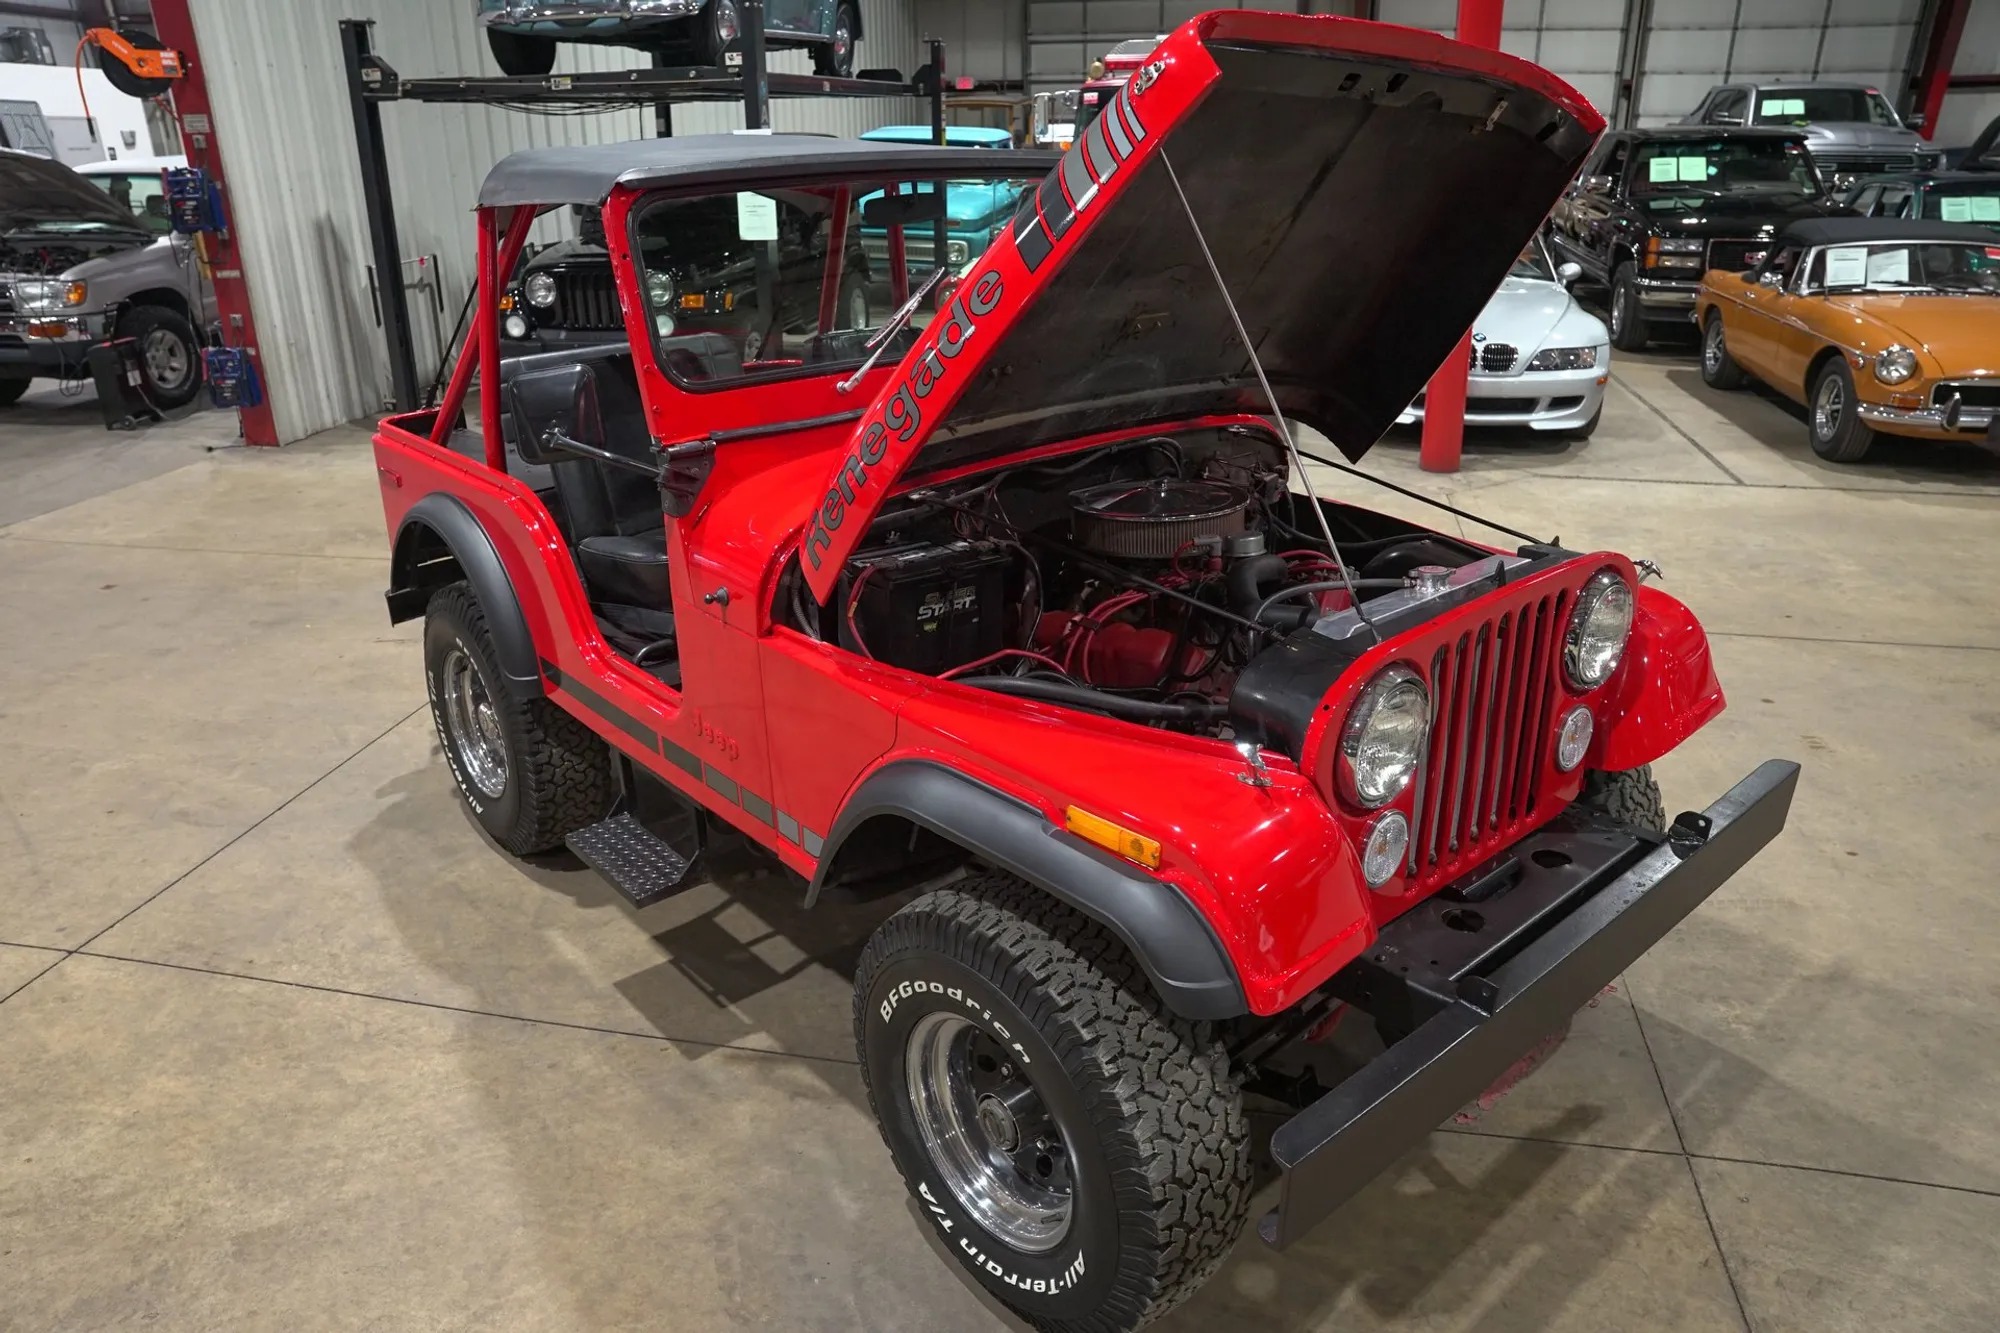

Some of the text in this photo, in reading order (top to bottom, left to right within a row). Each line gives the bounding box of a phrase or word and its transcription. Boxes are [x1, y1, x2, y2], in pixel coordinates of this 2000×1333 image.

[804, 268, 1004, 572] Renegade
[916, 595, 977, 620] START
[692, 707, 740, 763] Jeep
[879, 980, 1032, 1065] BFGoodrich
[917, 1181, 1087, 1296] All-Terrain T/A
